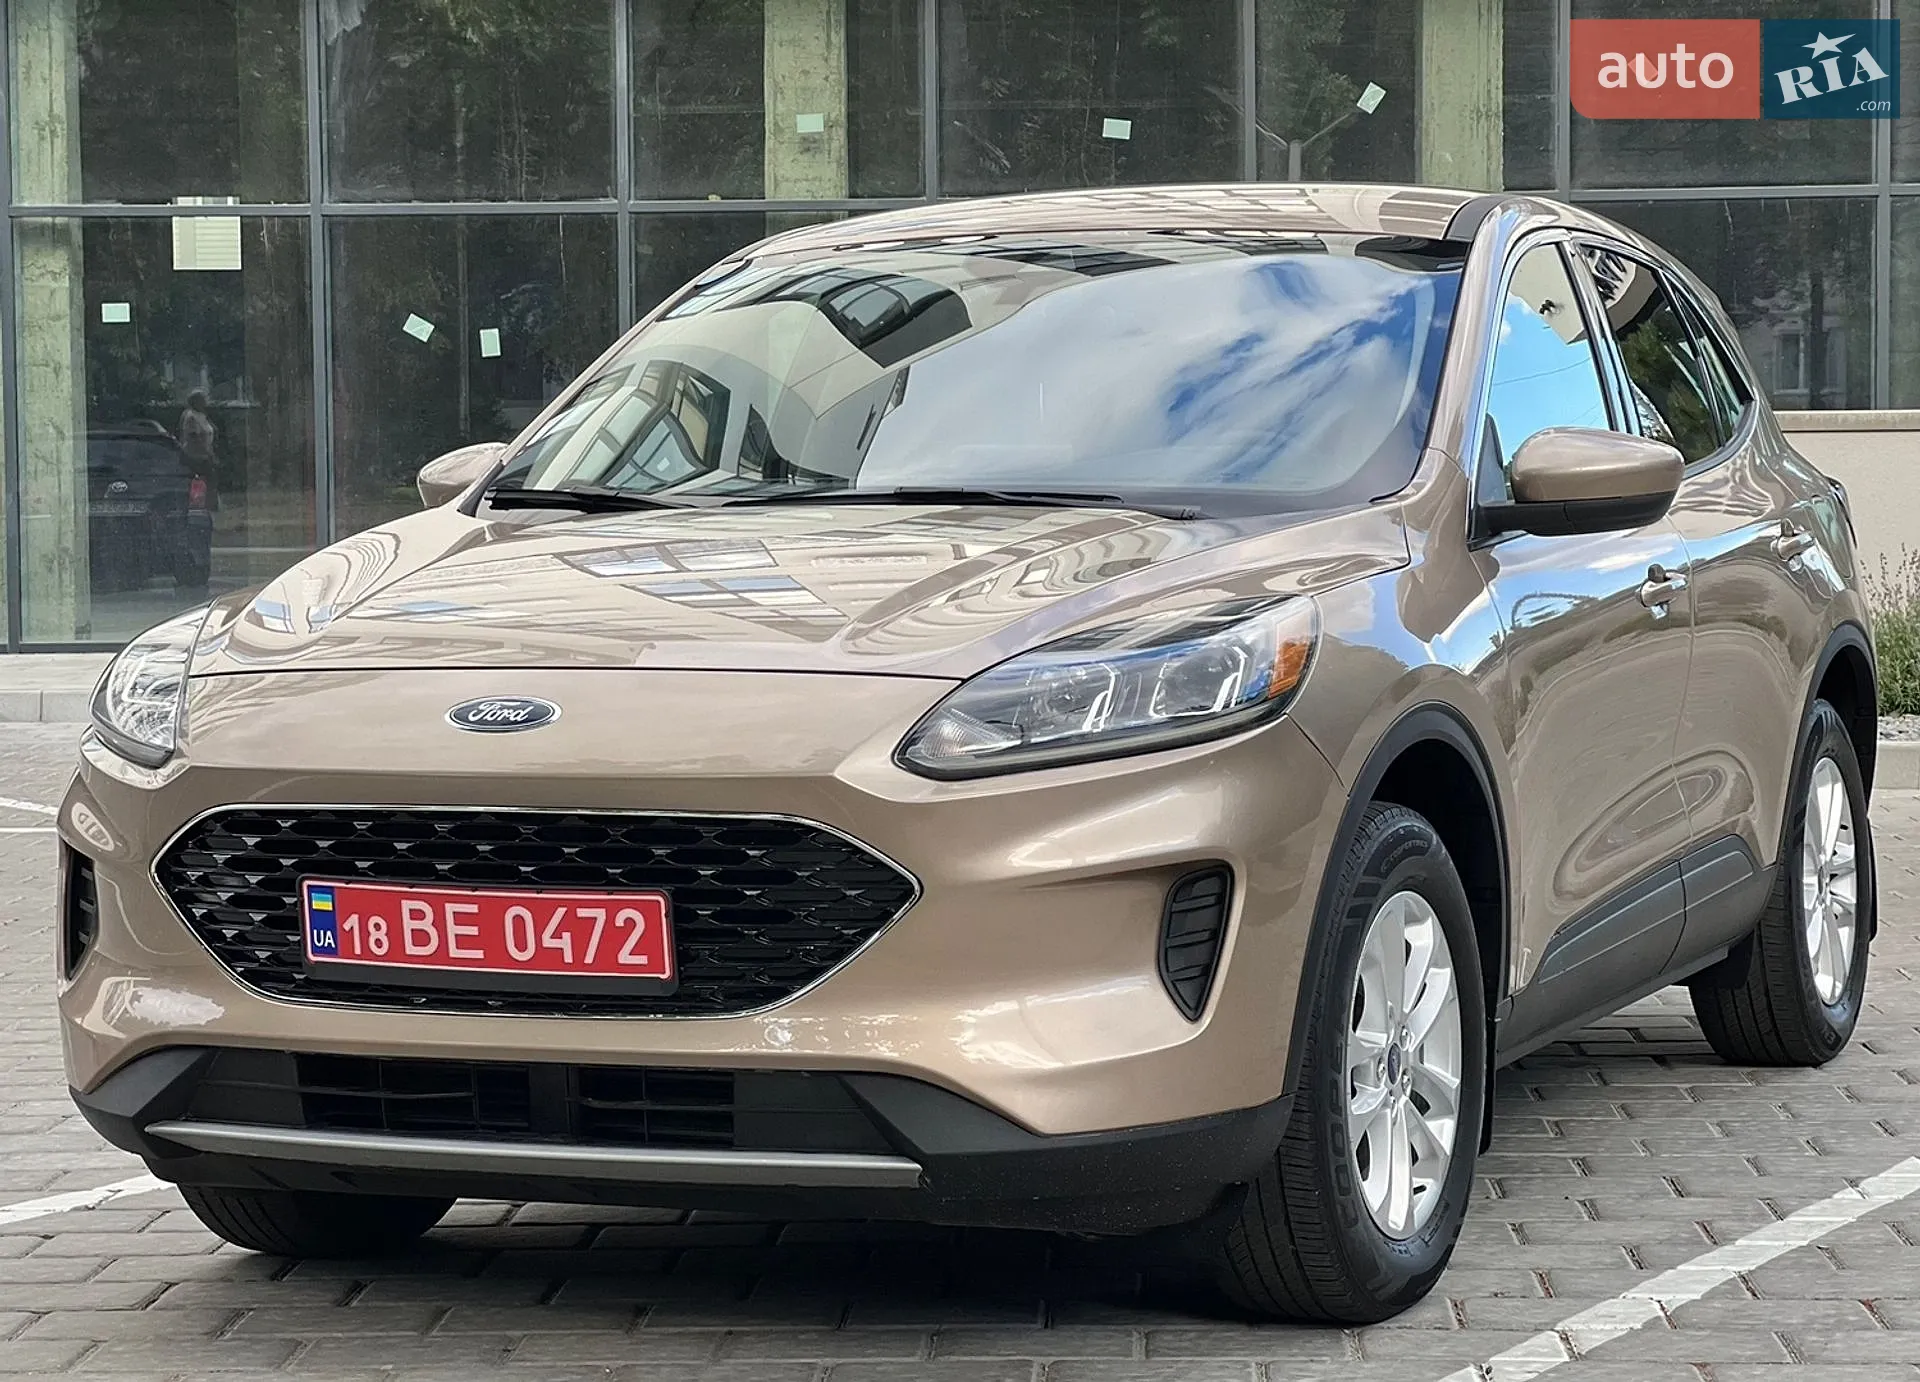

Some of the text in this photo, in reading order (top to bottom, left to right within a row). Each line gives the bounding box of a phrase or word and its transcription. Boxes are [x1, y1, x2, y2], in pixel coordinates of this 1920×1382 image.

[468, 701, 534, 722] Ford
[313, 929, 336, 949] UA
[342, 899, 649, 966] 18 BE 0472
